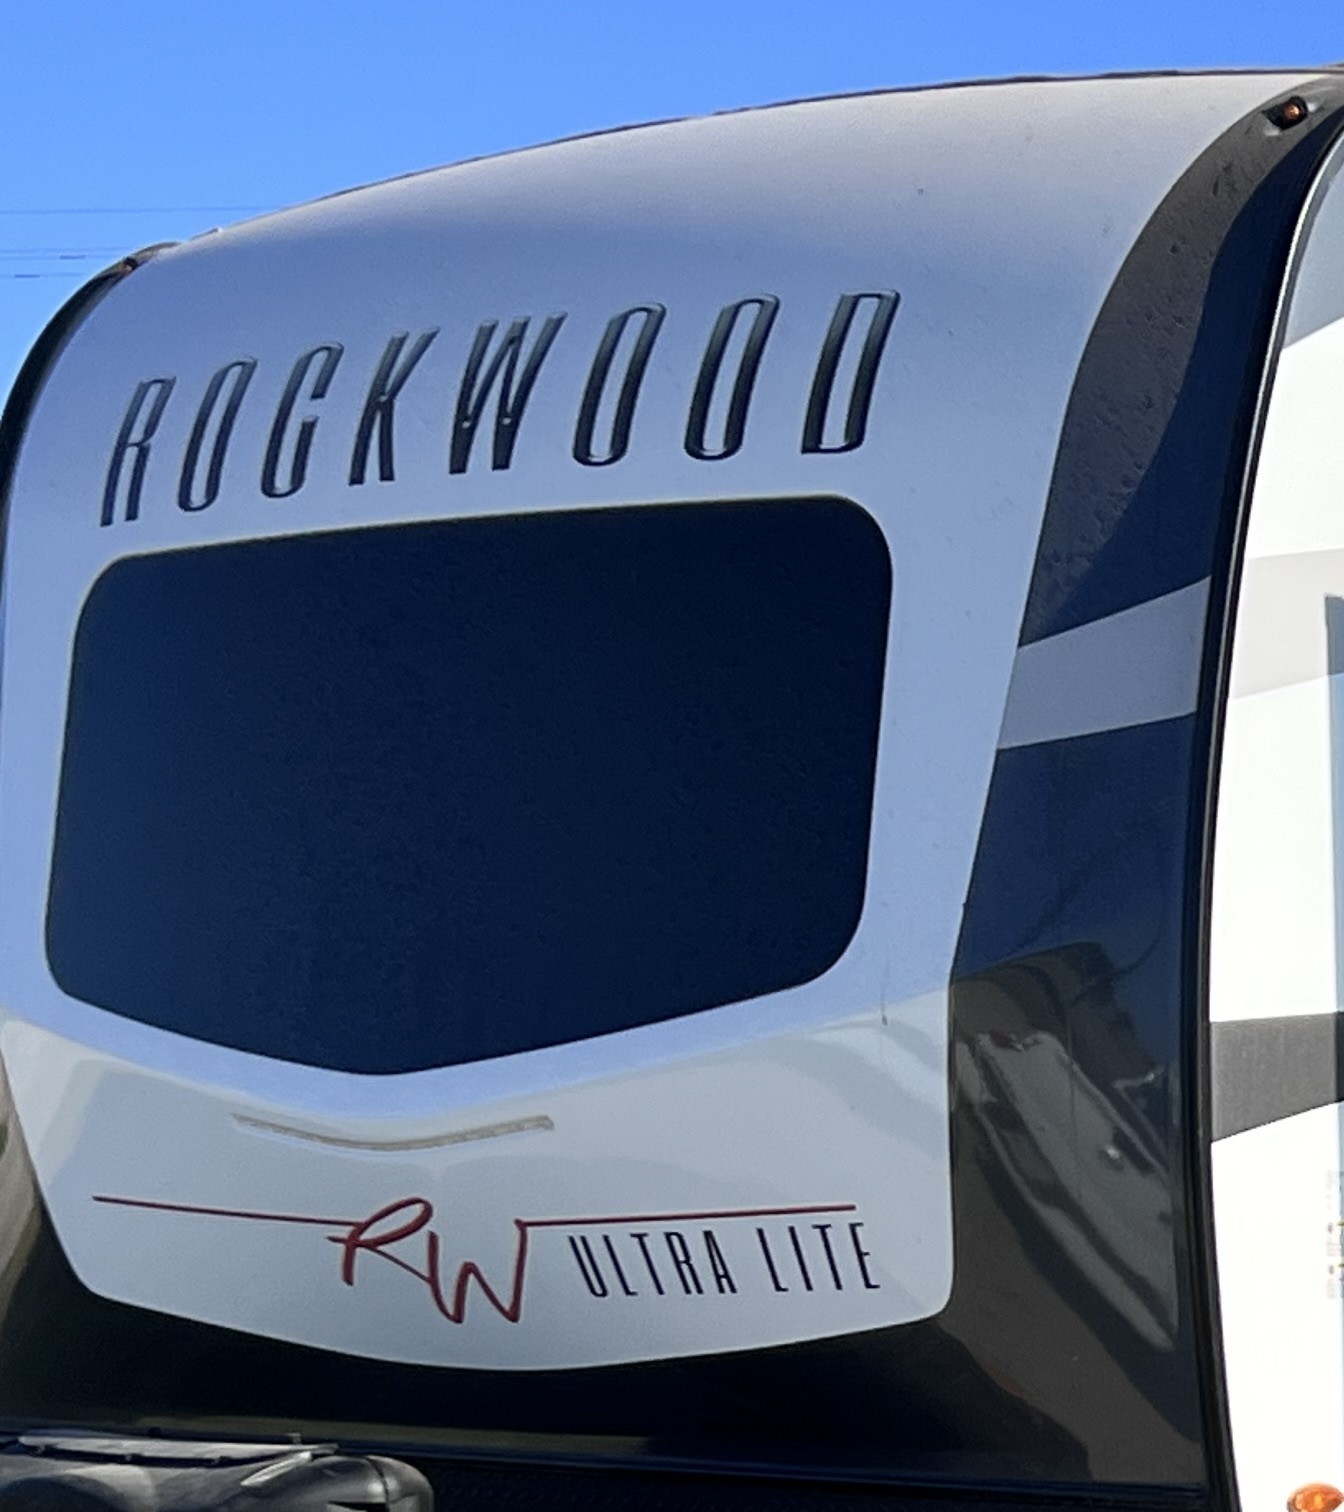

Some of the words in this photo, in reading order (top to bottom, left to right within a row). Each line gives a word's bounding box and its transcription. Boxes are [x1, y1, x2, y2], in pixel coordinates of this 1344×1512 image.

[101, 289, 901, 527] ROCKWOOD
[327, 1197, 527, 1324] RW
[568, 1229, 738, 1299] ULTRA
[758, 1222, 881, 1292] LITE
